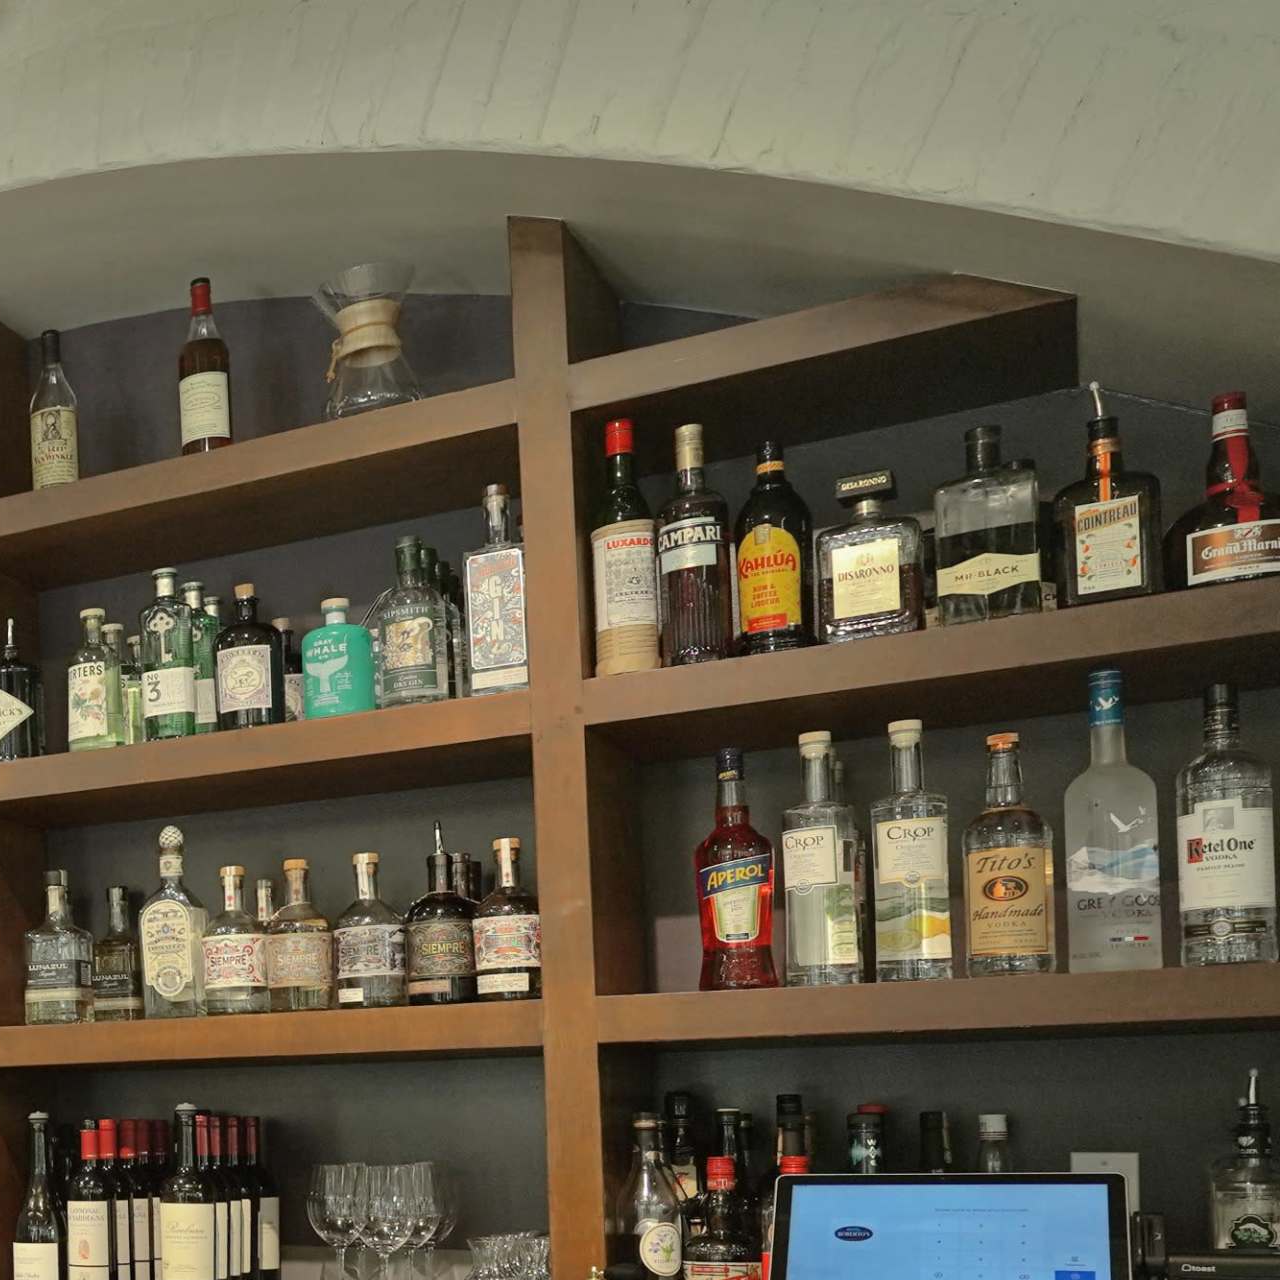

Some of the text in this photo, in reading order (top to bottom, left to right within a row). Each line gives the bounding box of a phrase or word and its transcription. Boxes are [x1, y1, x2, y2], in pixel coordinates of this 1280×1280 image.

[841, 475, 887, 491] DISARONNO
[1077, 502, 1137, 531] COINTREAU
[657, 525, 721, 552] CAMPARI
[739, 551, 797, 579] KAHLÚA
[838, 563, 894, 582] DISARONNO
[978, 564, 1020, 578] BLACK
[306, 644, 347, 657] WHALE
[147, 682, 162, 702] 3
[1226, 836, 1253, 851] One
[976, 852, 1035, 873] Tito's
[707, 864, 765, 891] APEROL
[972, 904, 1044, 922] Handmade
[421, 941, 465, 955] SIEMPRE
[210, 953, 248, 968] SIEMPRE
